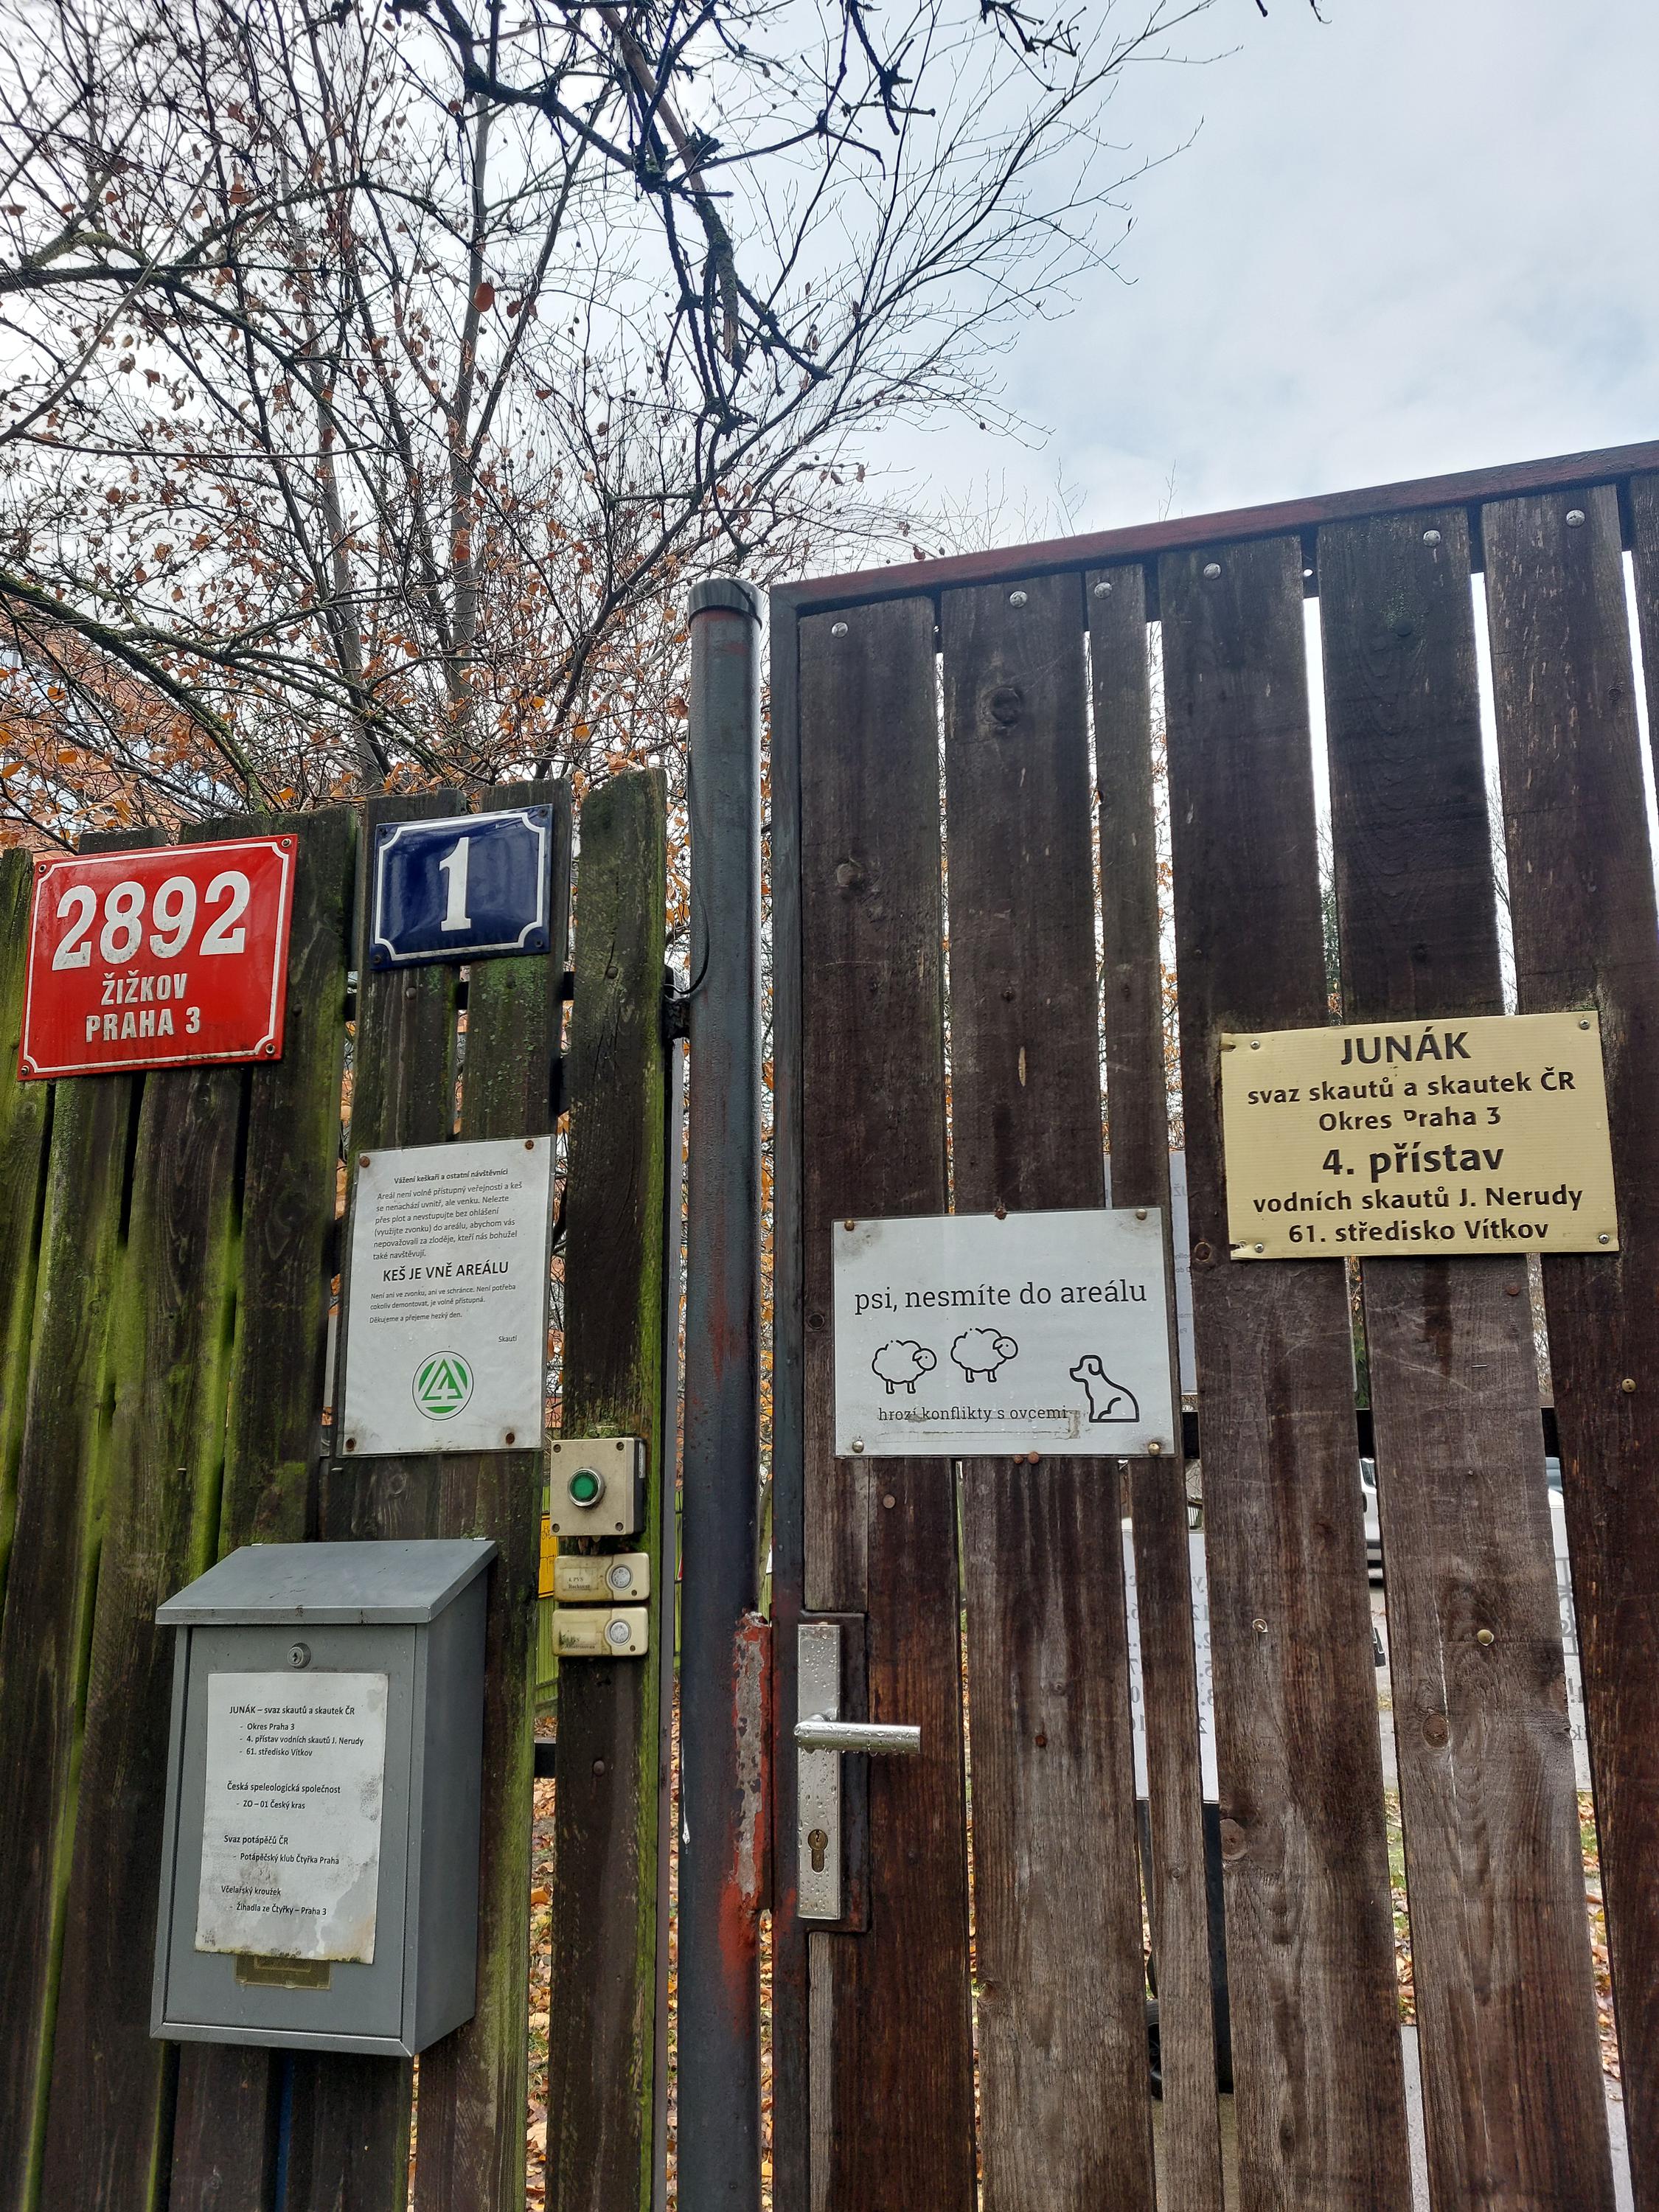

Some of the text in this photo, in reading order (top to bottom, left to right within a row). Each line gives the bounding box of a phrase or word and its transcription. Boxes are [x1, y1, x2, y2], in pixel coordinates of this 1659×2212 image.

[438, 836, 472, 932] 1
[52, 870, 251, 971] 2892
[100, 970, 188, 1006] ŽIŽKOV
[86, 1006, 201, 1043] PRAHA 3
[1340, 1026, 1472, 1065] JUNÁK
[1248, 1066, 1576, 1105] svaz skautů a skautek ČR
[1318, 1106, 1502, 1132] Okres Praha 3
[1322, 1141, 1504, 1183] 4. přístav
[394, 1175, 416, 1184] Vážení
[446, 1170, 470, 1180] ostatní
[470, 1168, 508, 1178] návštěvníci
[377, 1191, 396, 1200] Areál
[397, 1189, 412, 1198] není
[433, 1186, 466, 1197] přístupný
[467, 1183, 503, 1193] veřejnosti
[510, 1181, 523, 1189] keš
[1253, 1183, 1584, 1213] vodních skautů J. Nerudy
[385, 1201, 420, 1211] nenachází
[421, 1199, 444, 1208] uvnitř,
[456, 1197, 481, 1205] venku.
[481, 1195, 509, 1203] Nelezte
[375, 1216, 390, 1225] přes
[392, 1215, 406, 1224] plot
[412, 1211, 454, 1221] nevstupujte
[469, 1207, 500, 1217] ohlášení
[374, 1218, 515, 1237] (využijte zvonku) do areálu, abychom vás
[1289, 1217, 1549, 1244] 61. středisko Vítkov
[373, 1237, 419, 1248] nepovažovali
[428, 1235, 456, 1244] zloděje,
[457, 1233, 475, 1242] kteří
[489, 1230, 518, 1239] bohužel
[373, 1249, 427, 1260] také navštěvují.
[383, 1259, 509, 1282] KEŠ JE VNĚ AREÁLU
[404, 1290, 426, 1298] zvonku,
[447, 1287, 475, 1295] schránce.
[476, 1284, 491, 1293] Není
[492, 1283, 516, 1292] potřeba
[854, 1279, 1147, 1316] psi, nesmíte do areálu
[370, 1302, 391, 1310] cokoliv
[369, 1315, 399, 1324] Děkujeme
[405, 1314, 430, 1322] přejeme
[878, 1405, 1068, 1424] hrozí konflikty s ovcemi
[229, 1704, 256, 1715] JUNÁK
[264, 1707, 280, 1715] svaz
[282, 1705, 307, 1715] skautů
[315, 1706, 344, 1716] skautek
[345, 1705, 355, 1716] ČR
[247, 1722, 268, 1731] Okres
[269, 1723, 289, 1731] Praha
[255, 1735, 279, 1745] přístav
[279, 1735, 307, 1745] vodních
[307, 1735, 330, 1745] skautů
[331, 1737, 337, 1745] J.
[338, 1737, 364, 1747] Nerudy
[246, 1747, 257, 1756] 61.
[258, 1747, 289, 1756] středisko
[291, 1747, 313, 1757] Vítkov
[226, 1780, 341, 1794] Česká speleologická společnost
[243, 1800, 253, 1808] ZO
[270, 1799, 290, 1810] Český
[291, 1801, 305, 1809] kras
[223, 1834, 288, 1846] Svaz potápěčů ČR
[240, 1852, 279, 1863] Potápěčský
[279, 1854, 294, 1863] klub
[296, 1853, 318, 1865] Čtyřka
[319, 1856, 339, 1865] Praha
[221, 1885, 282, 1896] Včelařský kroužek
[236, 1902, 261, 1912] Žihadla
[271, 1903, 293, 1915] Čtyřky
[301, 1907, 321, 1916] Praha
[322, 1907, 327, 1916] 3
